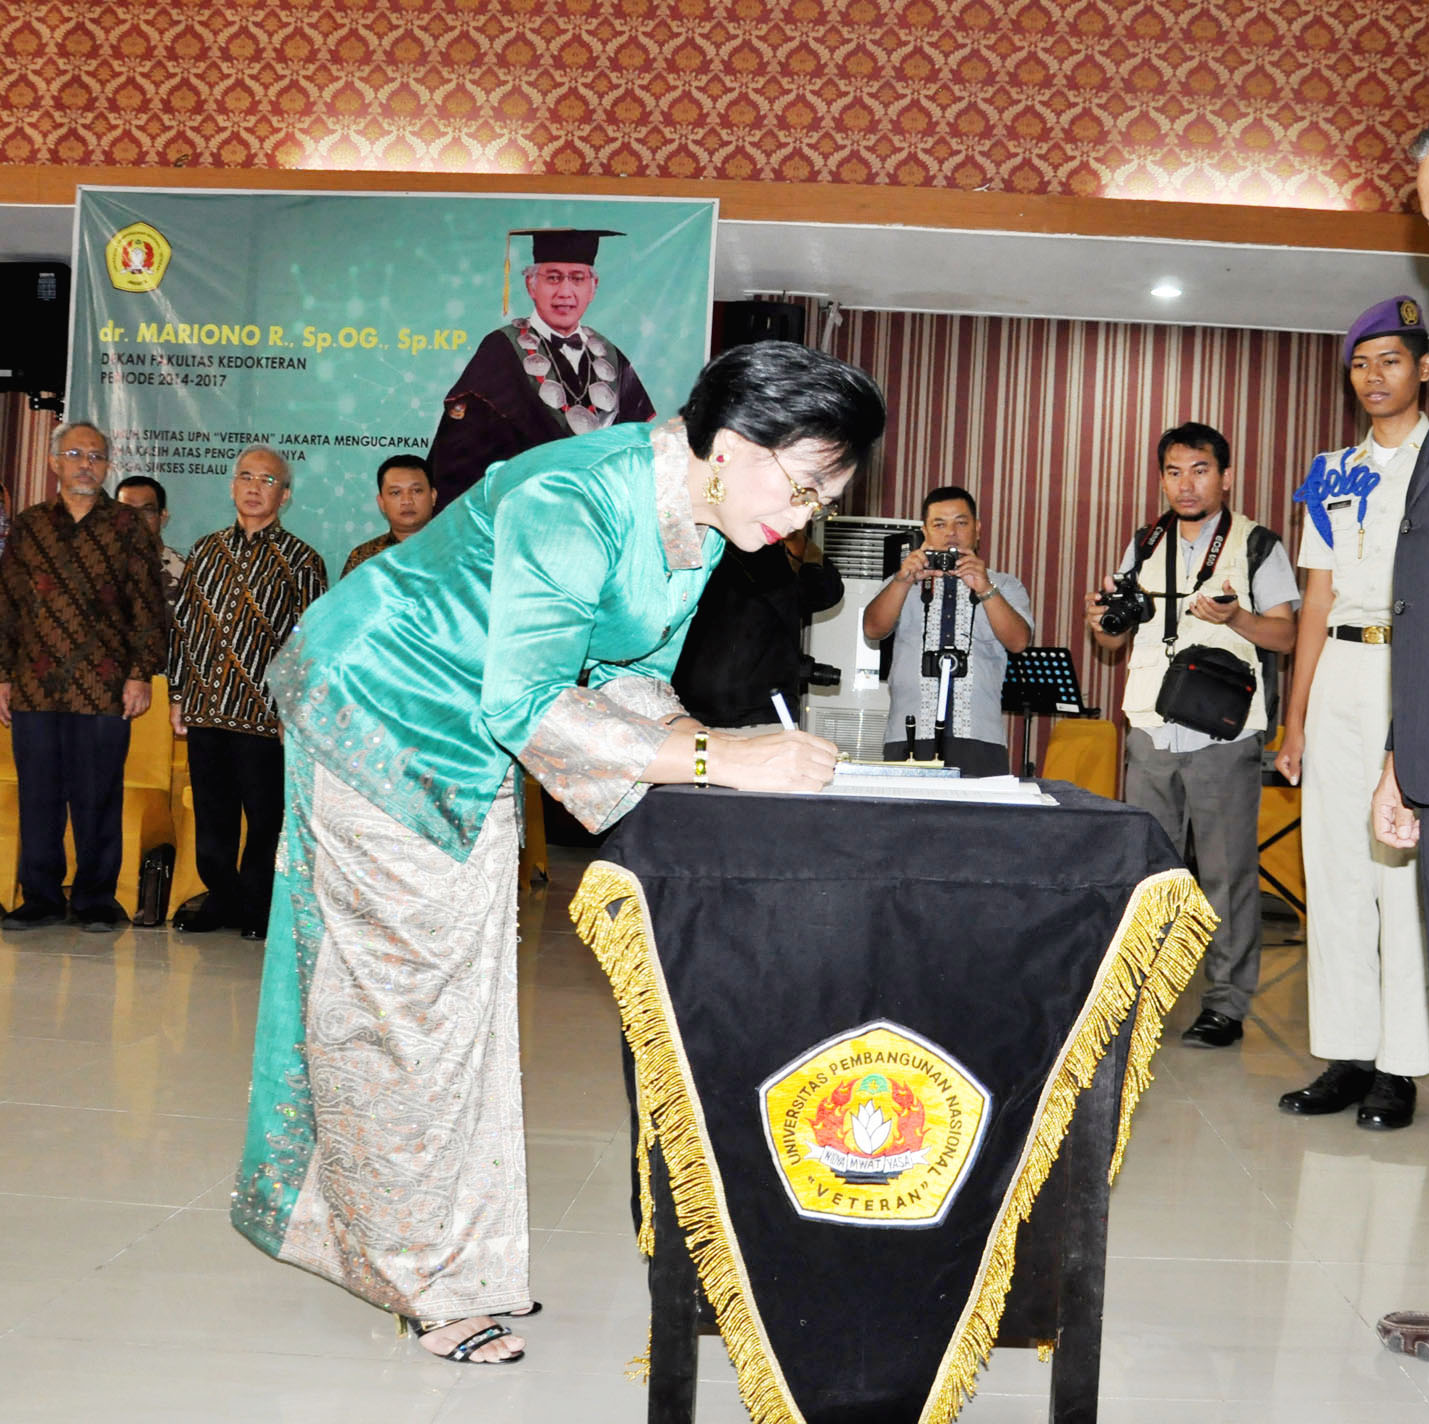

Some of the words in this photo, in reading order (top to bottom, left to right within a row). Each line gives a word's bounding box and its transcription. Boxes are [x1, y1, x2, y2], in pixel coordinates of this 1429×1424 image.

[99, 320, 129, 342] dr.
[136, 322, 261, 345] MARIONO
[397, 328, 472, 355] Sp.KP.
[218, 356, 306, 370] KEDOKTERAN
[143, 430, 184, 442] SIVITAS
[188, 431, 210, 442] UPN
[214, 432, 275, 444] "VETERAN"
[278, 433, 330, 446] JAKARTA
[334, 435, 429, 448] MENGUCAPKAN
[174, 447, 201, 458] ATAS
[188, 463, 227, 475] SELALU
[1211, 535, 1224, 553] EOS
[783, 1073, 828, 1165] UNIVERSITAS
[829, 1051, 952, 1093] PEMBANGUNAN
[927, 1095, 962, 1177] NASIONAL
[808, 1174, 928, 1211] "VETERAN"
